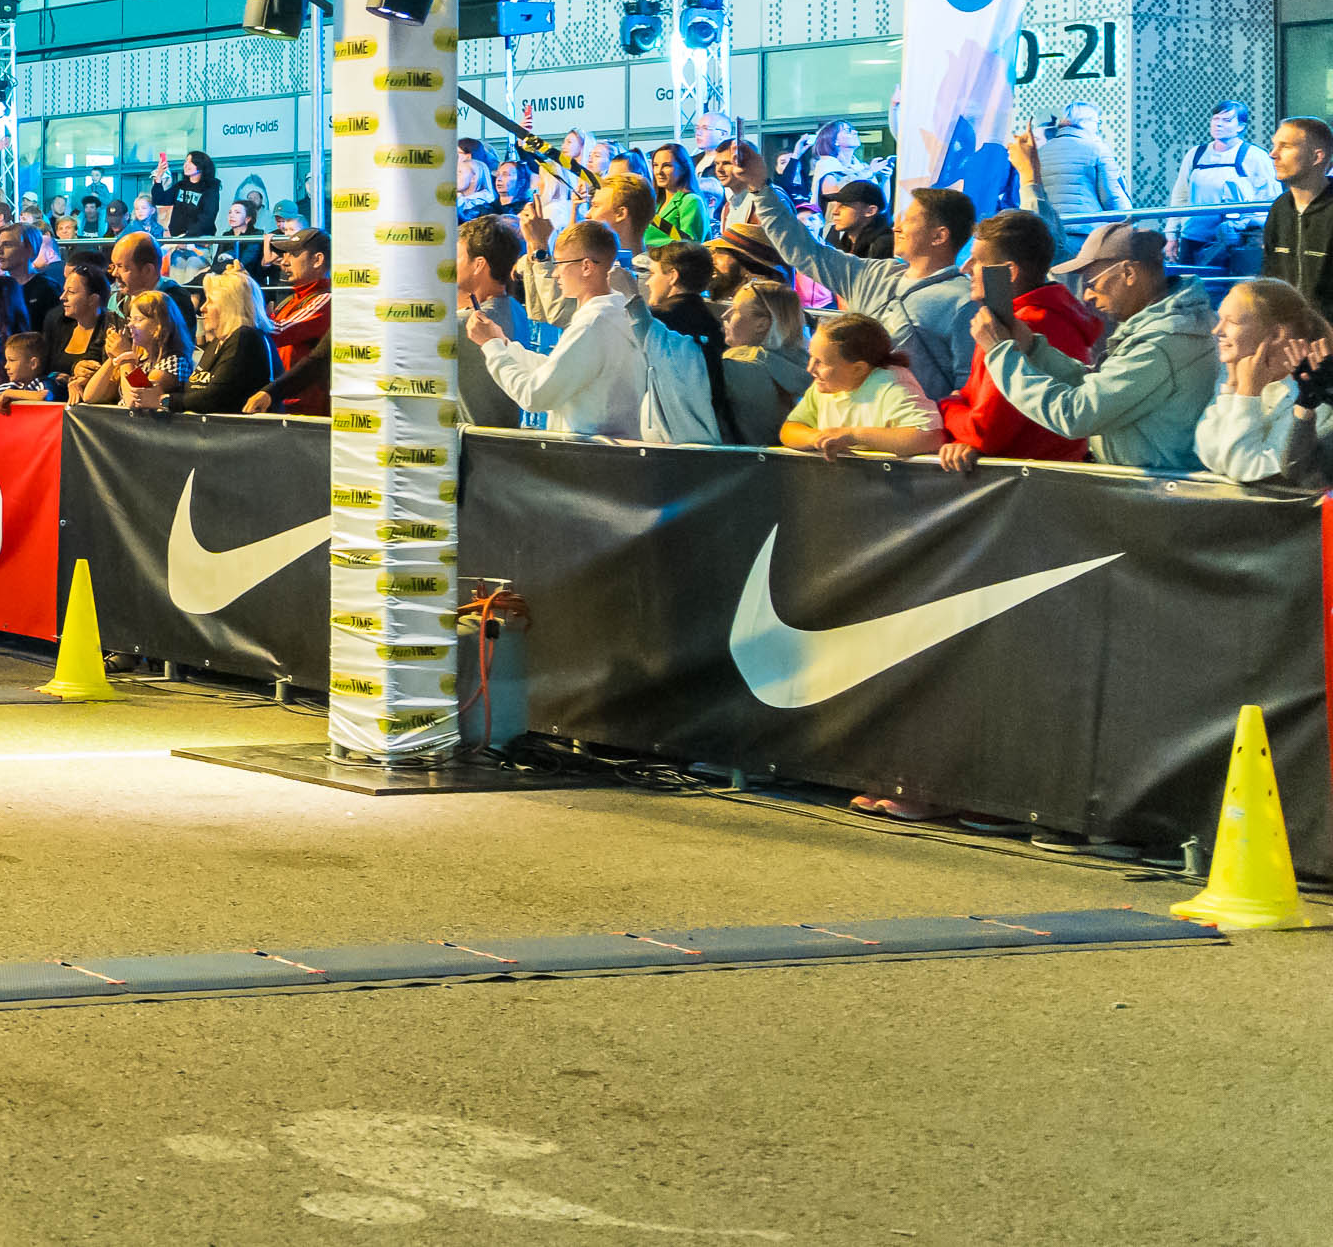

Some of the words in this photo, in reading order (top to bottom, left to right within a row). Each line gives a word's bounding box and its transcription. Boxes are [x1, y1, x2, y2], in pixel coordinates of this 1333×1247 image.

[334, 40, 368, 58] unTIME
[522, 95, 584, 112] SAMSUNG
[222, 123, 253, 137] Galaxy
[255, 120, 279, 133] Fold5
[334, 116, 369, 133] unTIME
